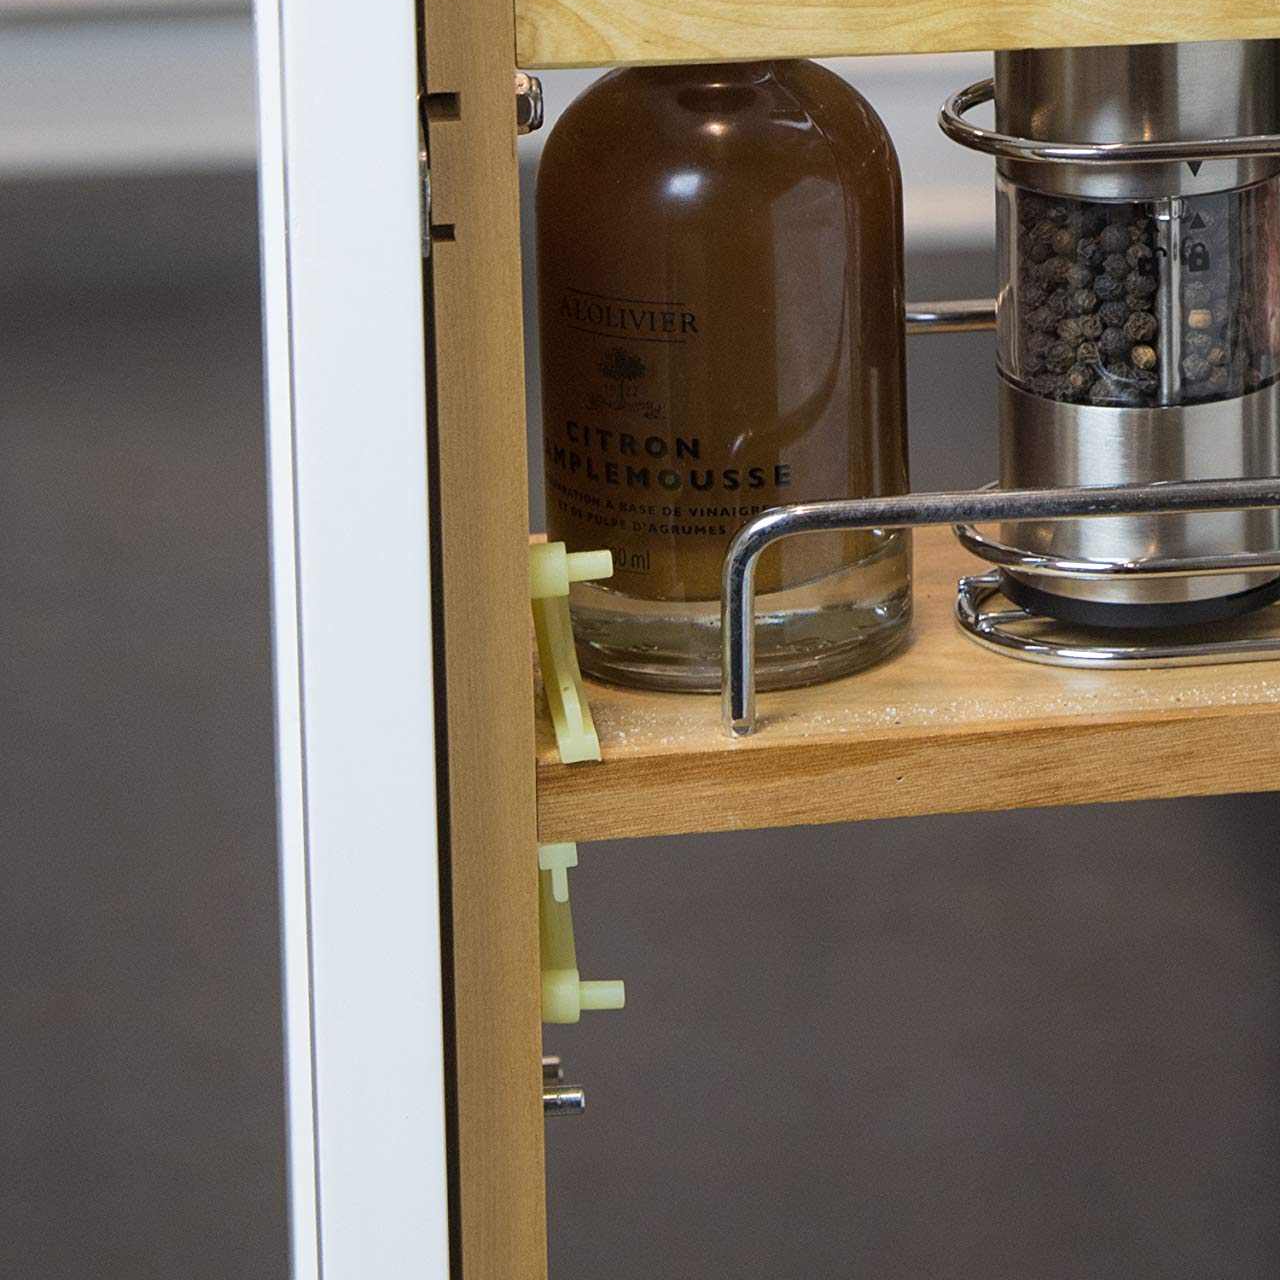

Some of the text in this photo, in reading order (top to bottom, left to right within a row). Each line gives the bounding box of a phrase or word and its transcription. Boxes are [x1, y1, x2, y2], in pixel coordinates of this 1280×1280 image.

[564, 420, 702, 461] CITRON
[618, 501, 655, 516] BASE
[662, 506, 682, 518] DE
[632, 521, 726, 536] D'AGRUMES
[630, 550, 651, 571] ml
